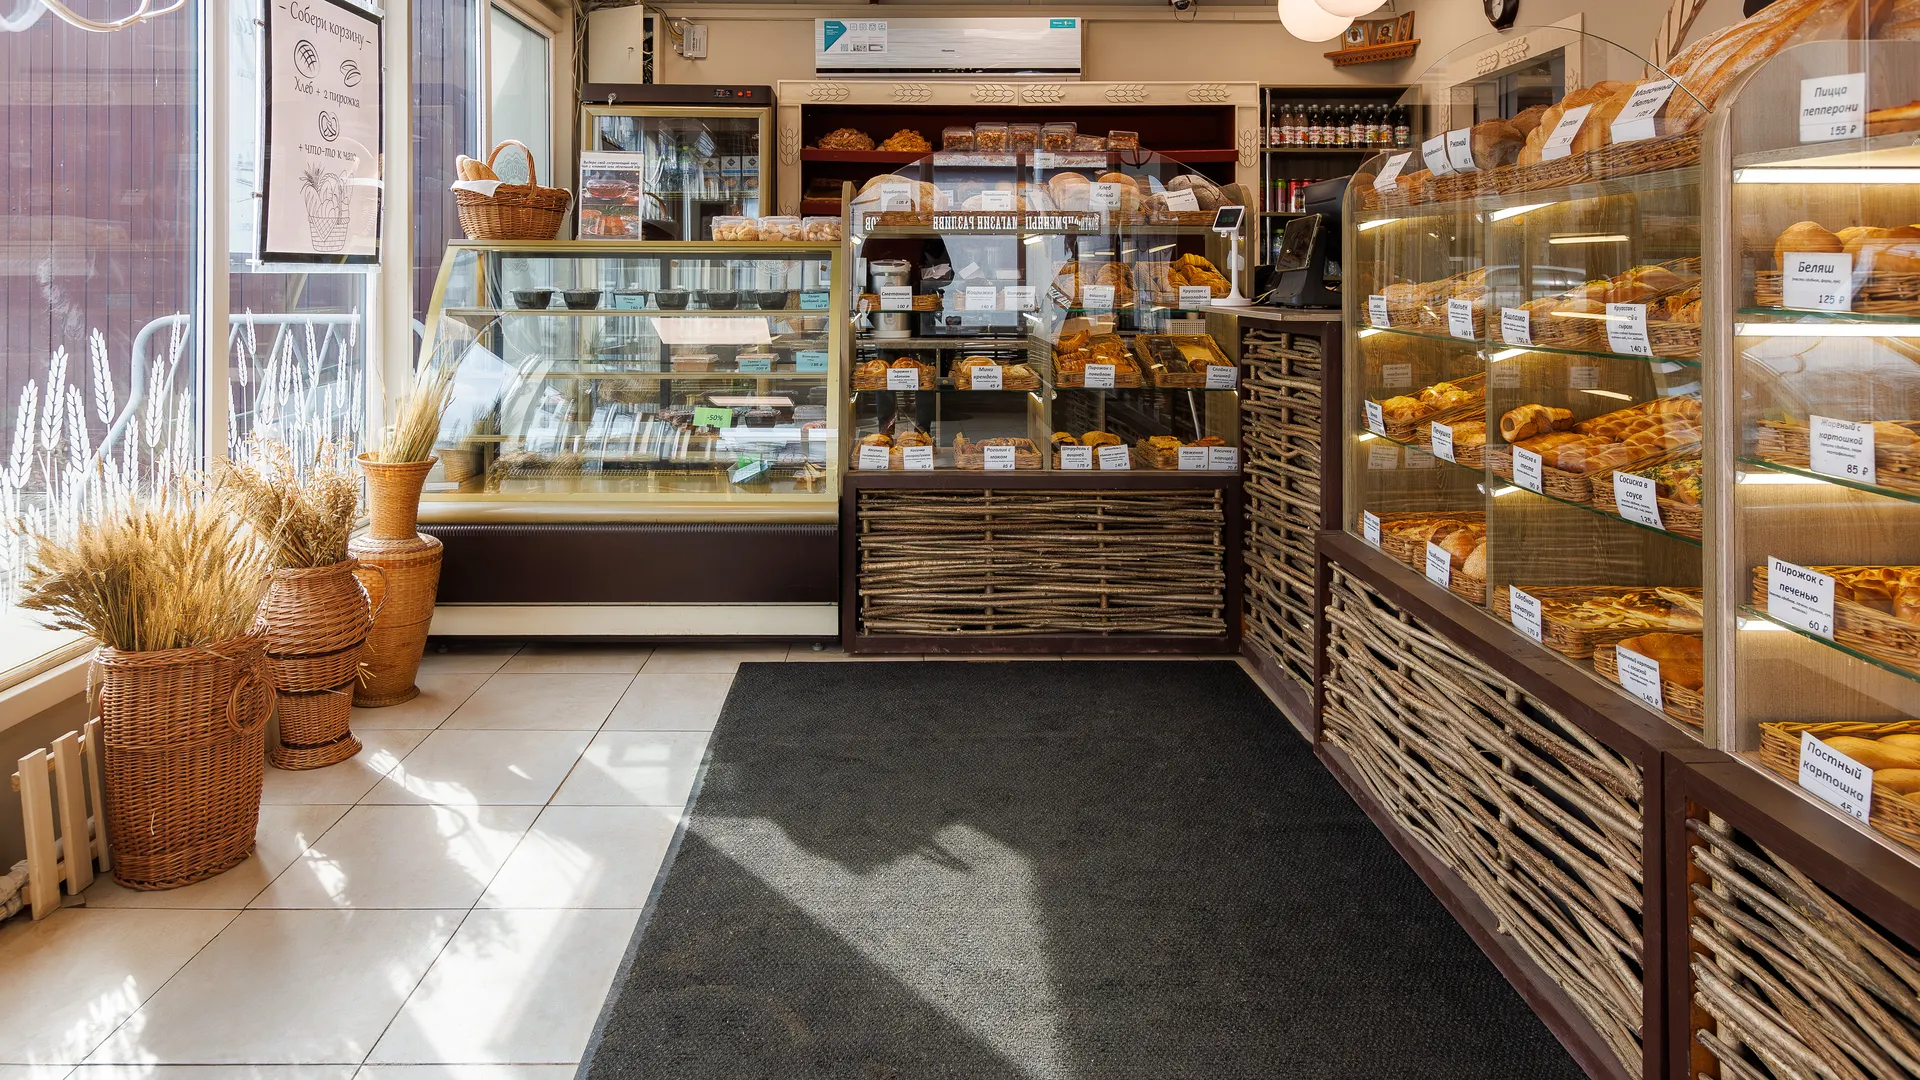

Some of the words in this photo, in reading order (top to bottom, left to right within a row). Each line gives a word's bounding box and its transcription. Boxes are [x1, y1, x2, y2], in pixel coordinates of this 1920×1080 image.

[290, 1, 327, 33] Собери
[329, 21, 365, 51] корзину
[294, 76, 314, 96] Хлеб
[324, 90, 328, 99] 2
[329, 91, 361, 109] пирожка
[1632, 81, 1675, 98] Молочный
[1814, 86, 1848, 98] Пицца
[1631, 97, 1659, 108] батон
[1803, 103, 1859, 117] пепперони
[1560, 118, 1579, 128] Батон
[1830, 125, 1847, 136] 155
[1450, 137, 1466, 148] Ржаной
[304, 143, 336, 160] что-то
[337, 151, 342, 160] к
[1797, 261, 1835, 274] Беляш
[1818, 294, 1835, 304] 125
[1613, 305, 1632, 313] Круассан
[1618, 323, 1633, 332] сыром
[1630, 345, 1641, 353] 140
[706, 413, 724, 422] -50%
[1820, 418, 1856, 432] Жареный
[1819, 431, 1863, 445] картошкой
[1517, 451, 1534, 463] Сосиска
[1520, 462, 1534, 473] тесте
[1846, 464, 1859, 475] 85
[1619, 474, 1643, 488] Сосиска
[1625, 490, 1643, 501] соусе
[1775, 561, 1817, 584] Пирожок
[1818, 578, 1824, 586] с
[1779, 583, 1818, 603] печенью
[1513, 603, 1535, 619] хачапури
[1808, 620, 1819, 631] 60
[1807, 741, 1862, 780] Постный
[1802, 760, 1864, 802] картошка
[1840, 801, 1852, 814] 45
